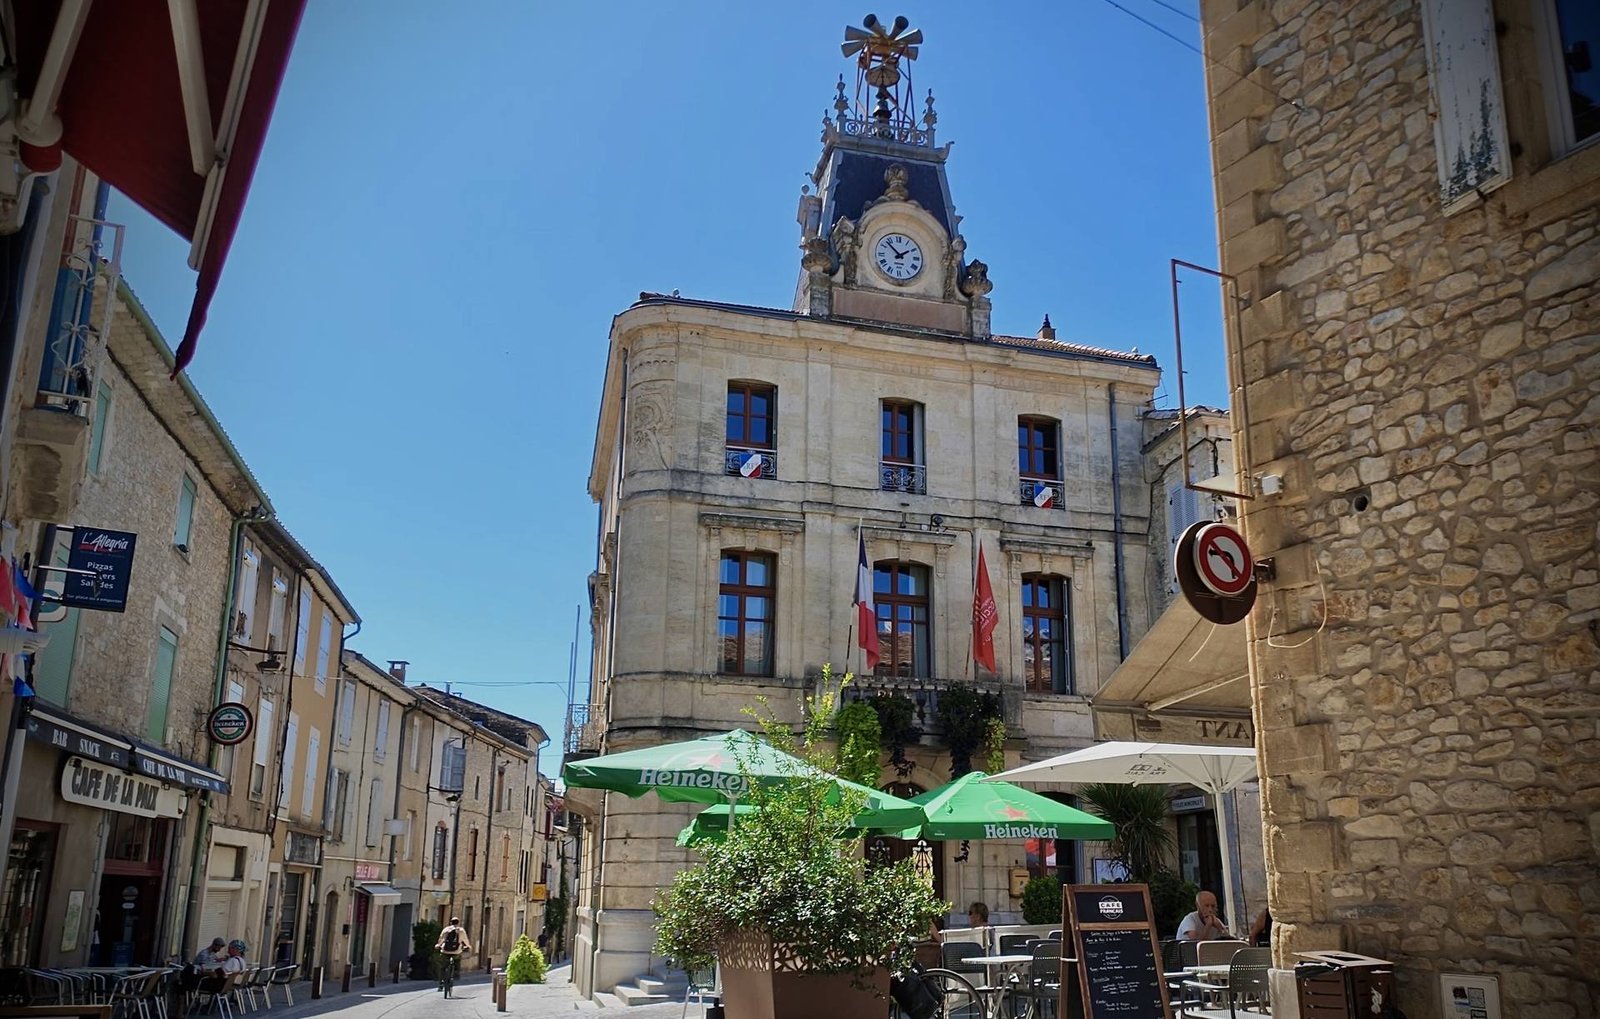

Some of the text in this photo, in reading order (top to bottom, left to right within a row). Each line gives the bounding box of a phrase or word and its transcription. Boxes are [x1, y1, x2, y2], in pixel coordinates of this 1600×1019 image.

[81, 532, 129, 552] L'Allegria
[87, 561, 114, 571] Pizzas
[80, 579, 114, 589] Saldes
[52, 729, 100, 757] BAR SNACK
[157, 764, 165, 778] DE
[166, 767, 175, 779] LA
[103, 773, 121, 803] DE
[120, 777, 135, 806] LA
[135, 782, 159, 811] PAIX
[984, 823, 1058, 839] Heineken
